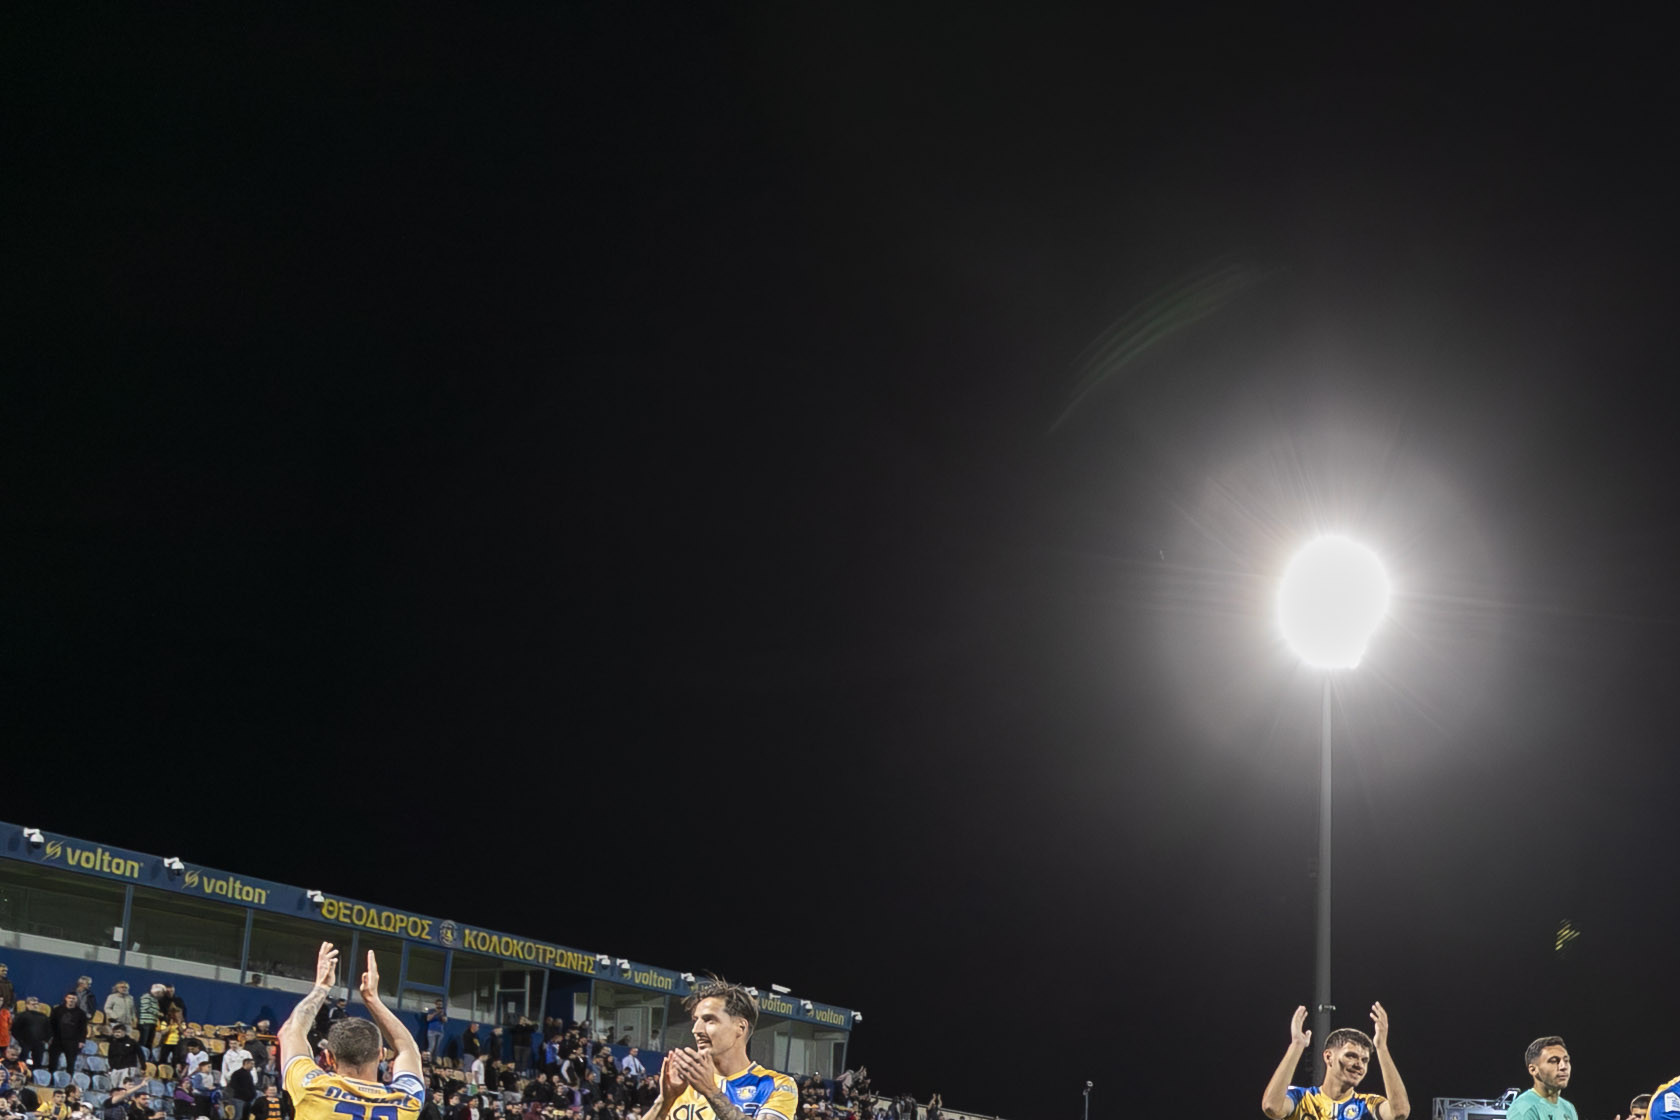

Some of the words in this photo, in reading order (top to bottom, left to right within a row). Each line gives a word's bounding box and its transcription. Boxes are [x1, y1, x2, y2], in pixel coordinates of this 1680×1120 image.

[66, 848, 140, 879] volton
[203, 875, 267, 905] volton
[321, 898, 433, 940] ΘΕΟΔΩΡΟΣ
[463, 929, 597, 974] ΚΟΛΟΚΟΤΡΩΝΗΣ
[634, 970, 672, 991] volton
[761, 998, 793, 1015] volton
[815, 1009, 845, 1026] volton
